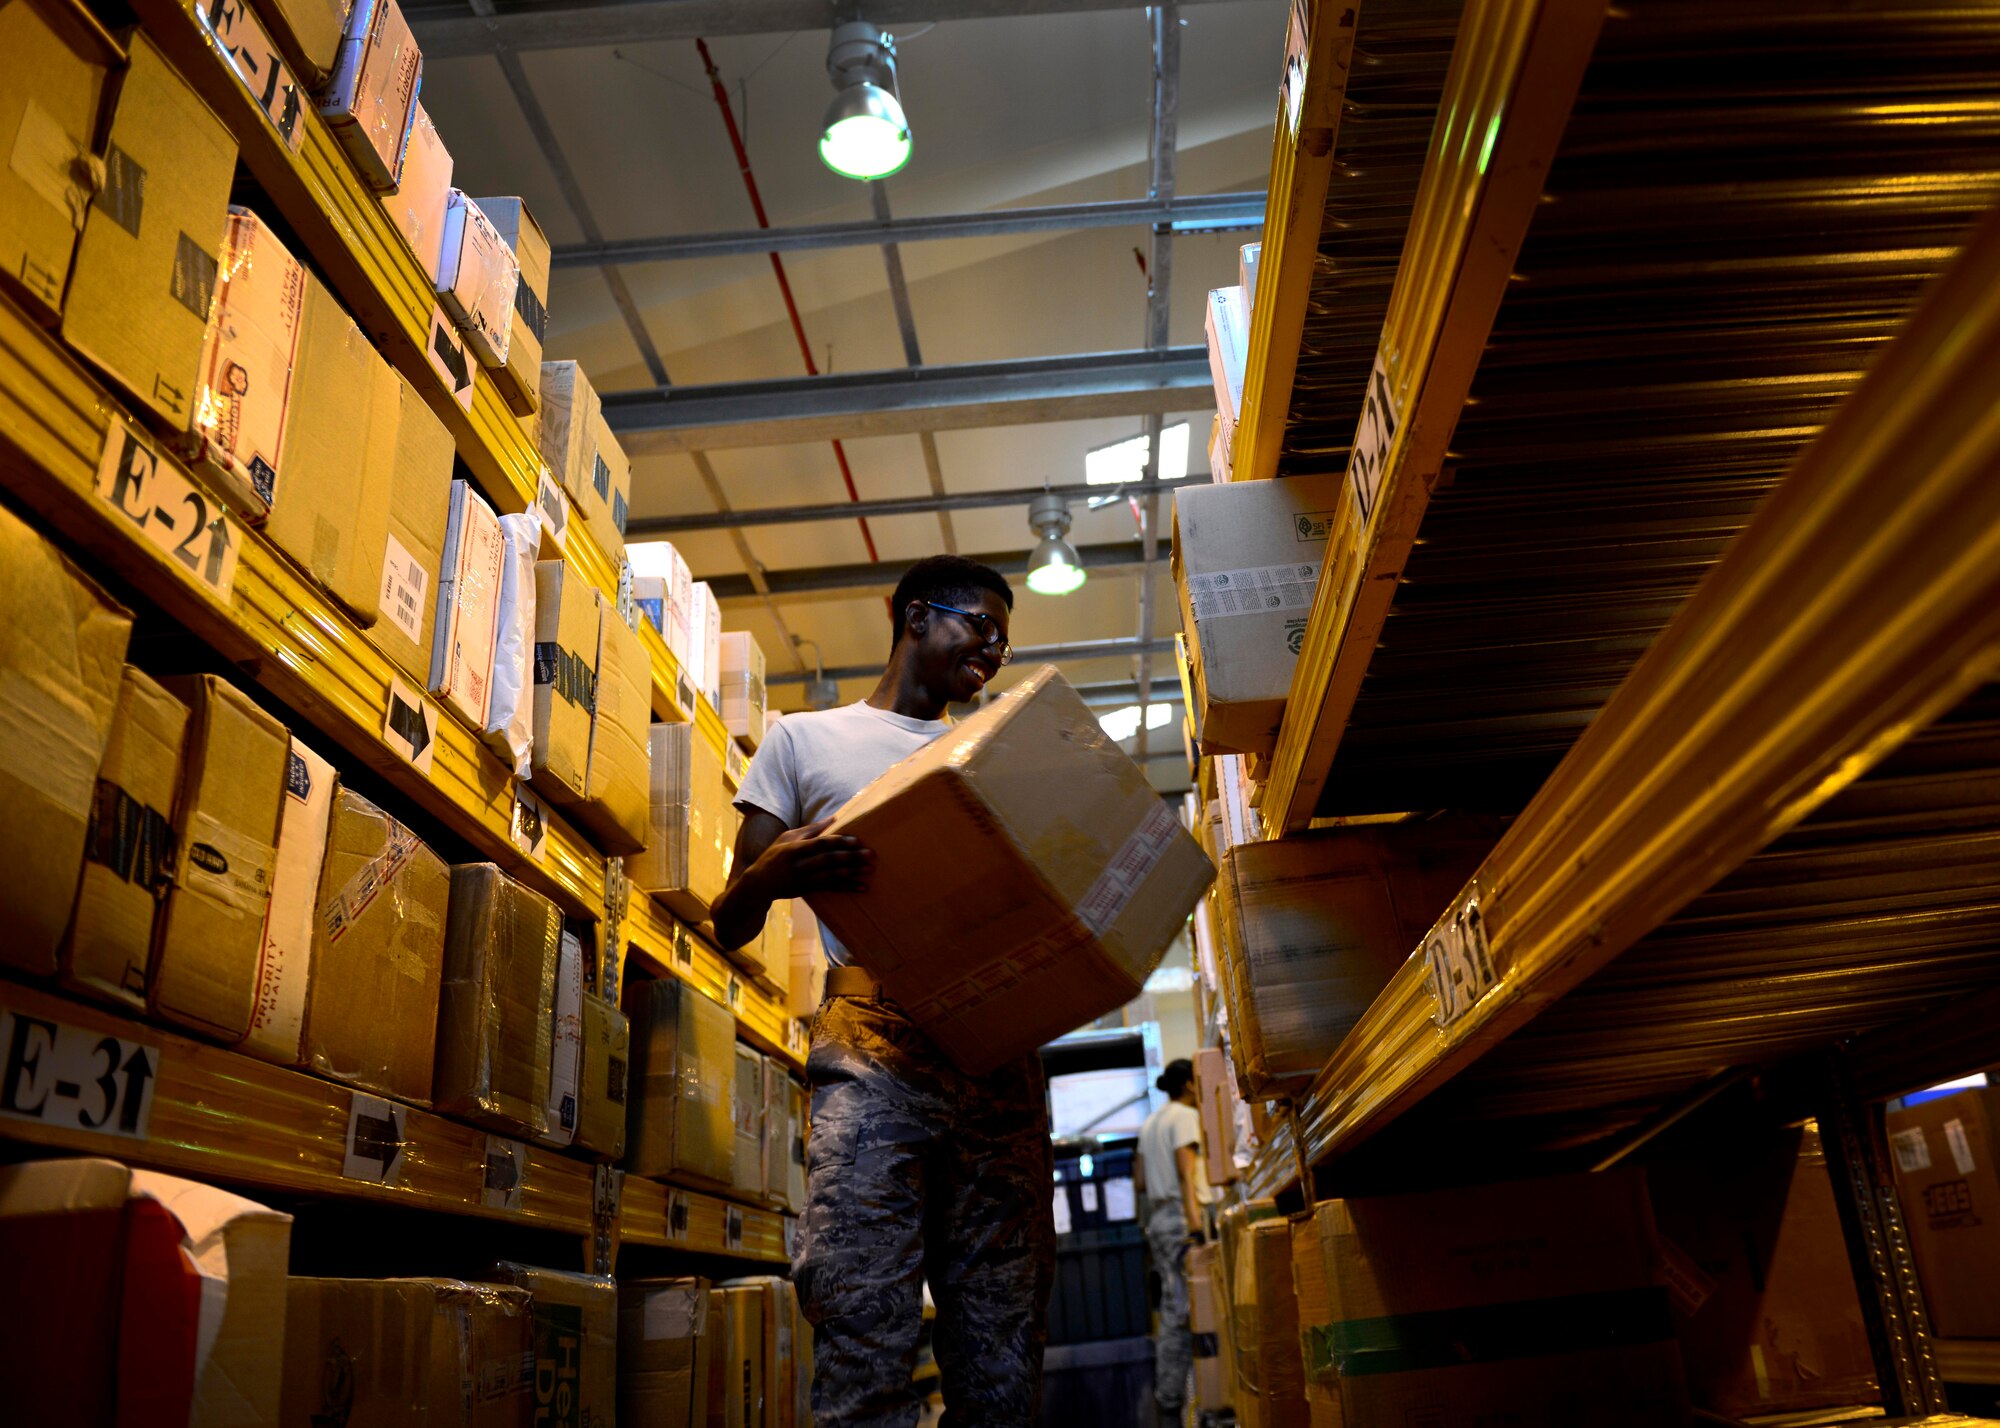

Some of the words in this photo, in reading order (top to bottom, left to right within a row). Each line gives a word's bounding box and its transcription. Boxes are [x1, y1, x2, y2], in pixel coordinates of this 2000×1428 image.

[400, 49, 417, 111] PRIORITY
[289, 756, 297, 788] TRACKED
[254, 936, 278, 1030] PRIORITY
[269, 963, 283, 1012] MAIL
